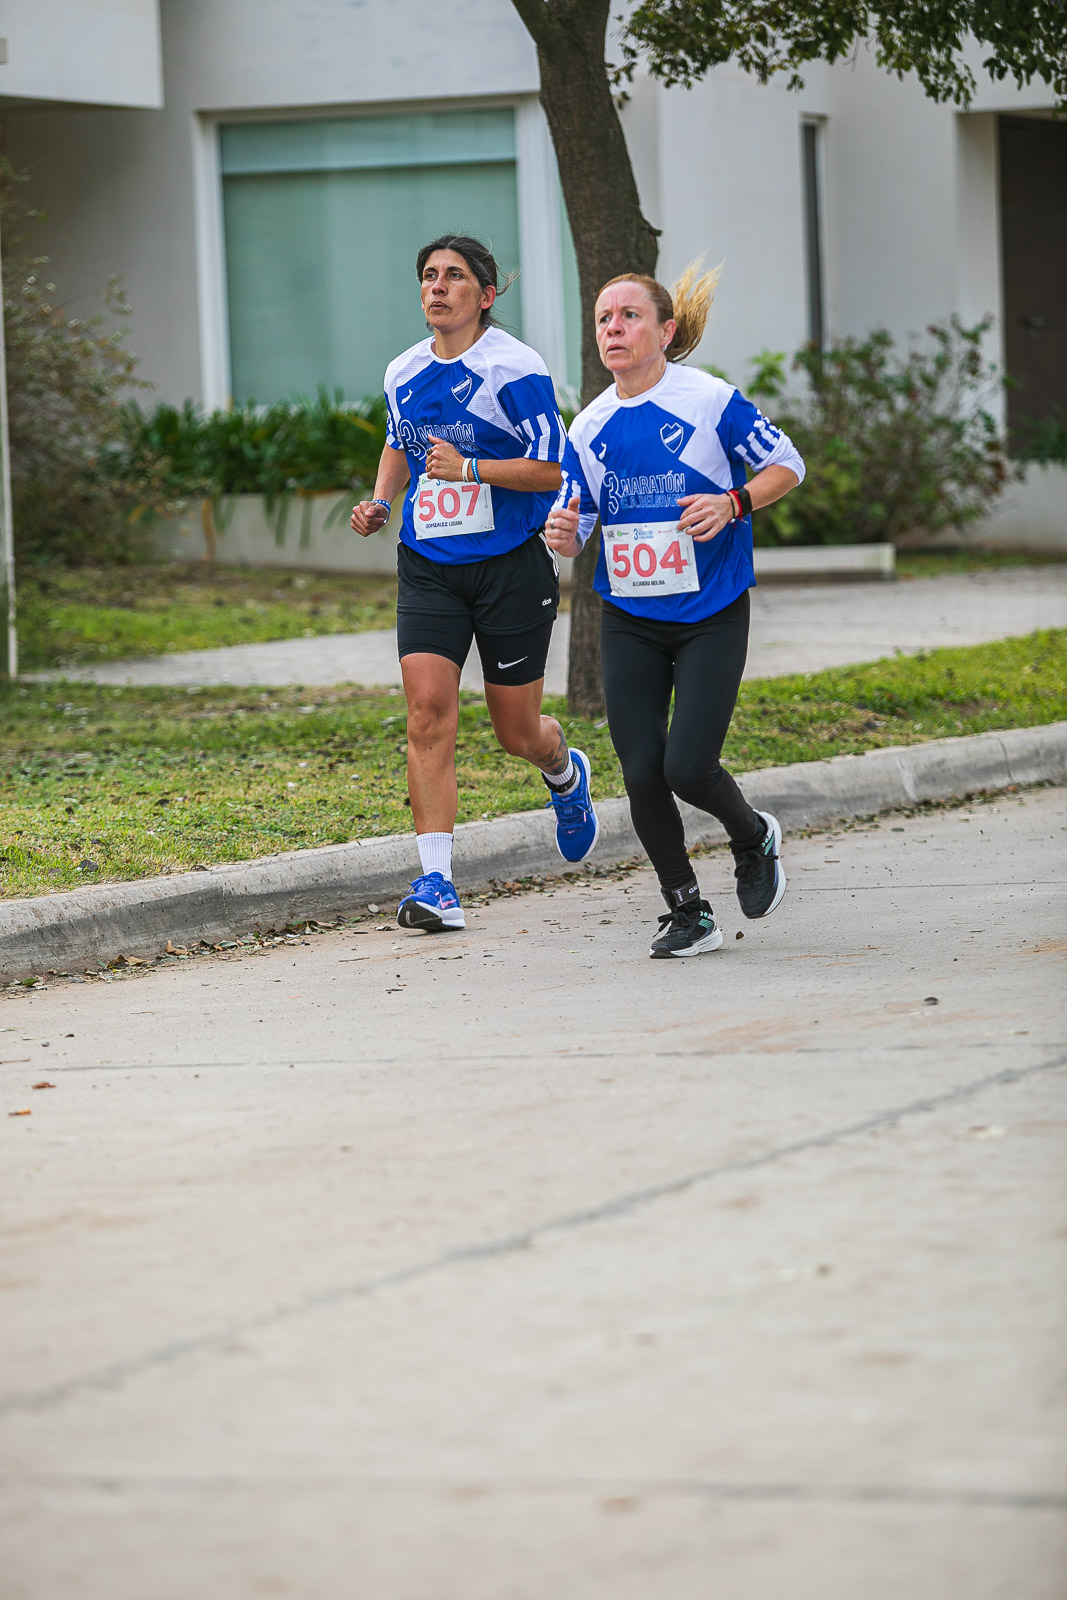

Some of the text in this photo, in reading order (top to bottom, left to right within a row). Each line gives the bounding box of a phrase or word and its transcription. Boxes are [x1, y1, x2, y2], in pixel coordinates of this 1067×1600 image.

[400, 419, 427, 461] 3
[418, 484, 481, 522] 507
[602, 470, 686, 515] 3 MARATÓN
[613, 540, 688, 578] 504
